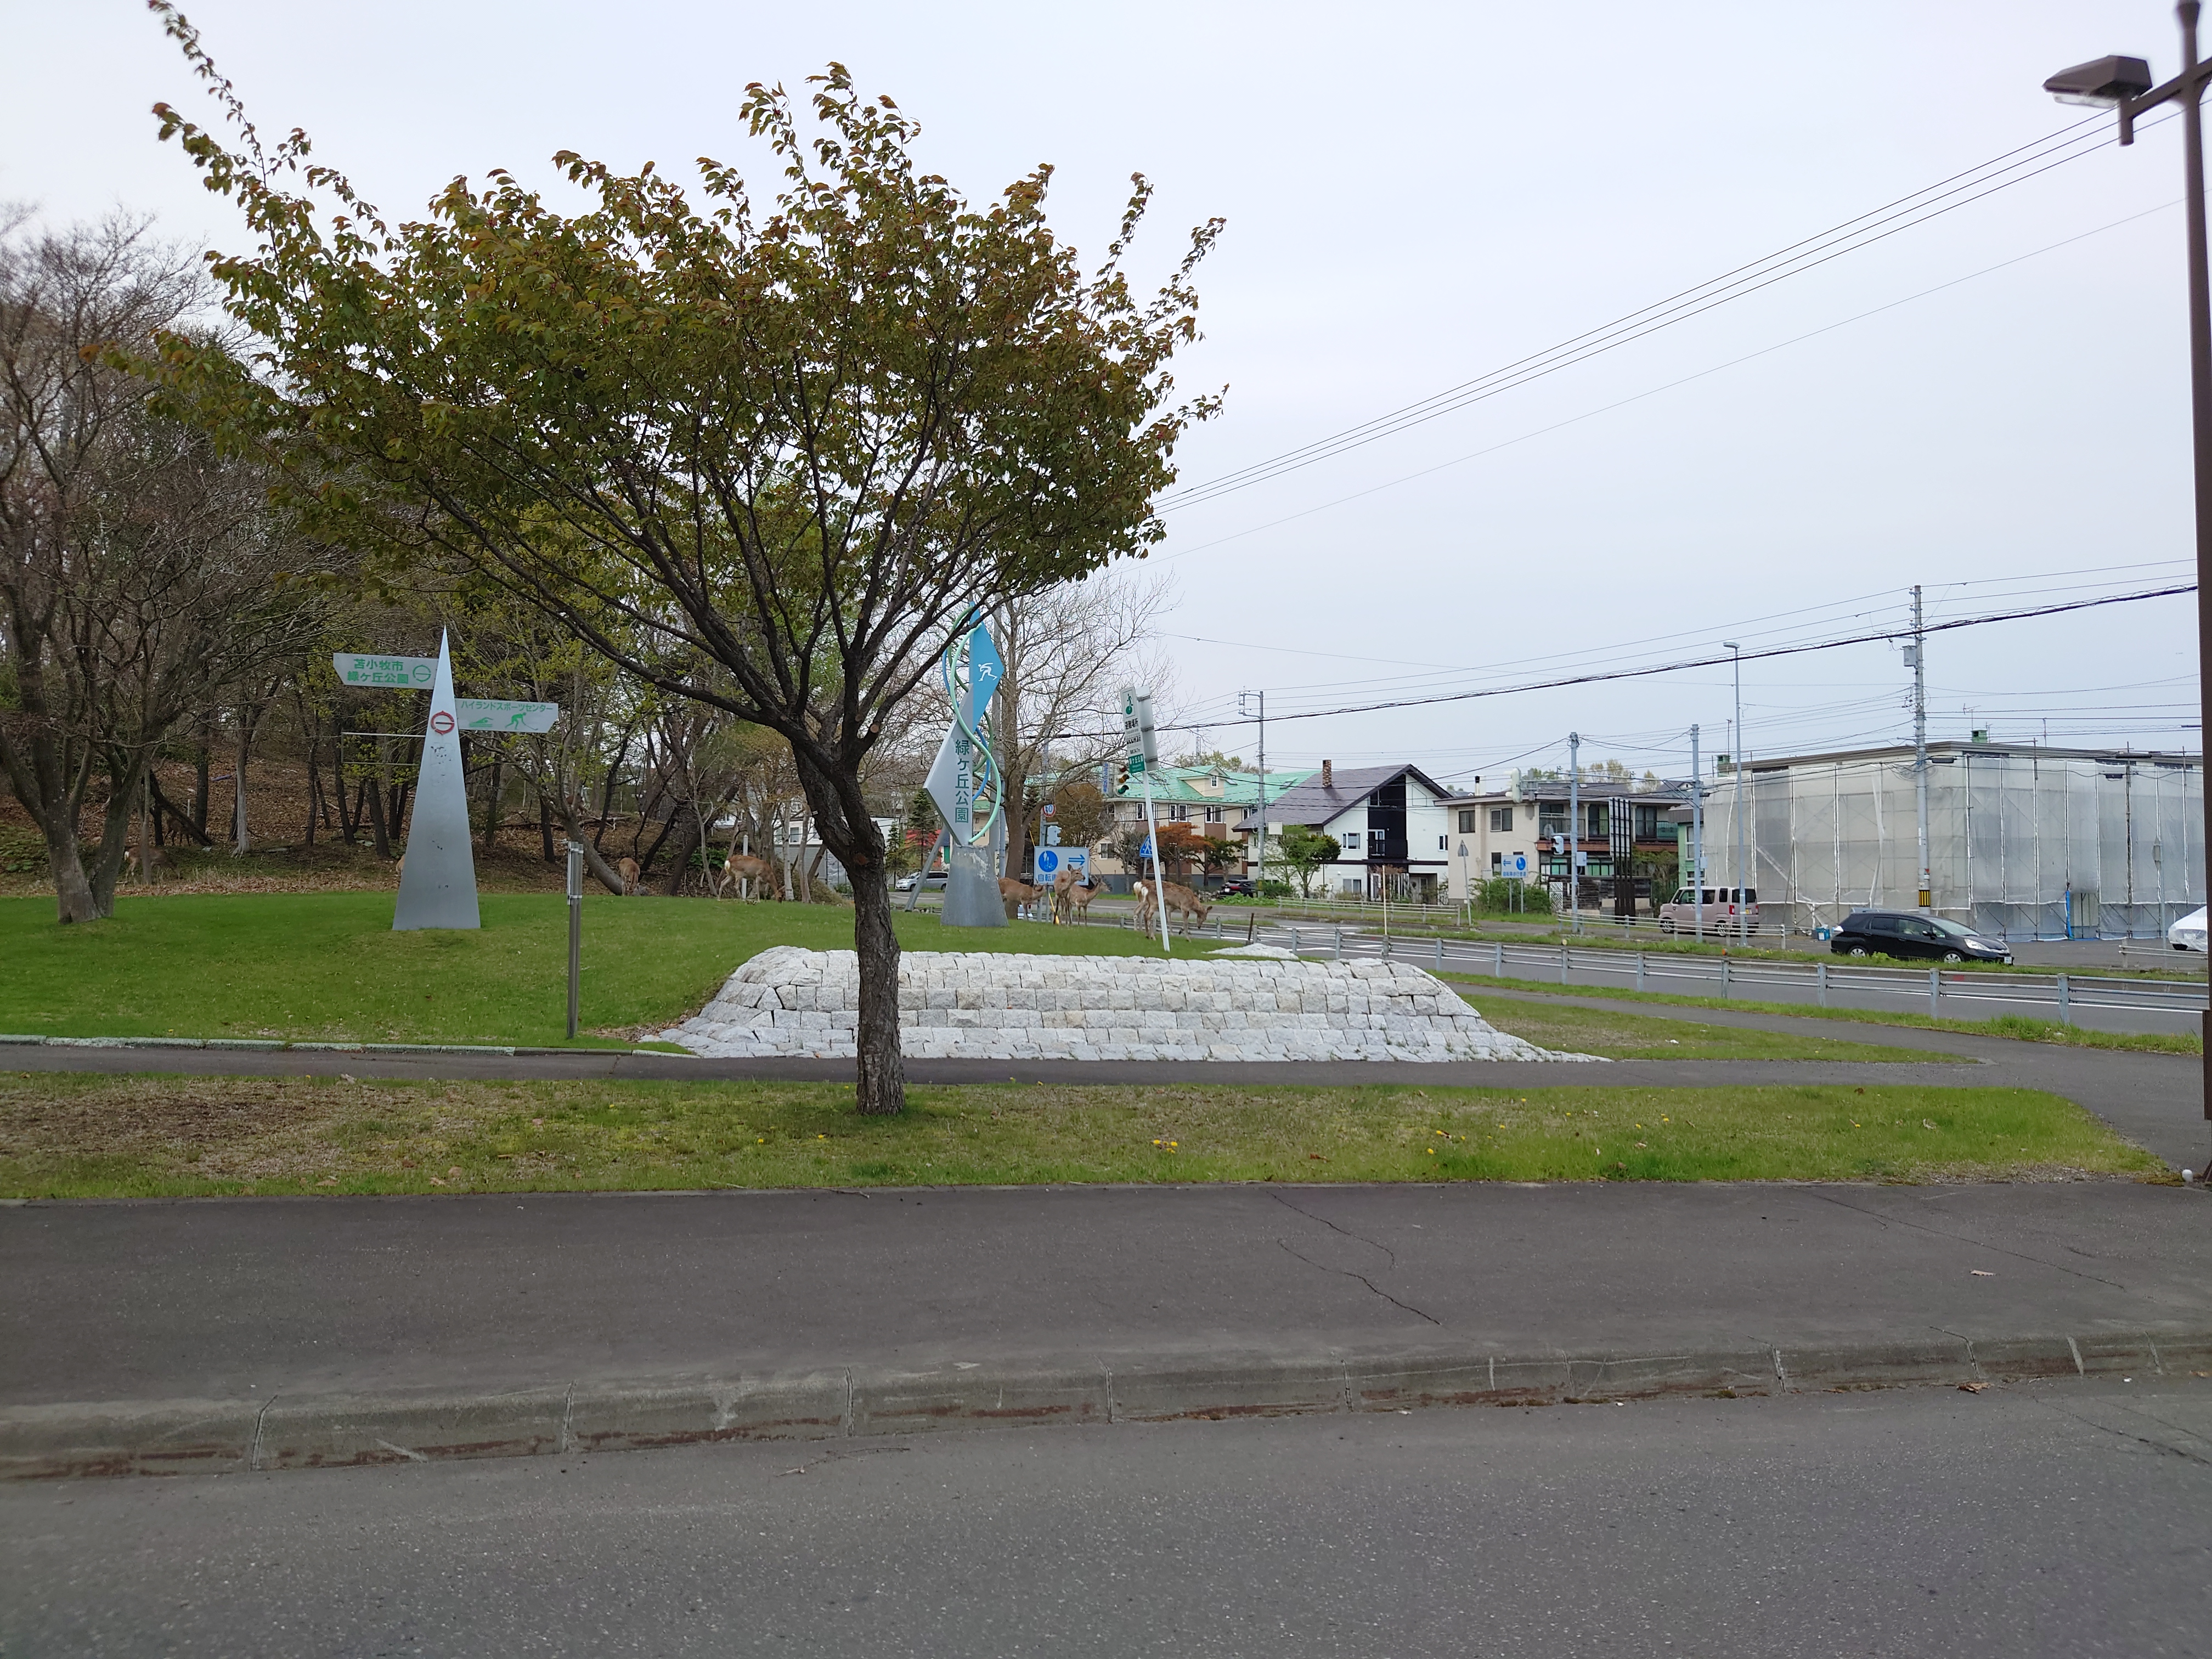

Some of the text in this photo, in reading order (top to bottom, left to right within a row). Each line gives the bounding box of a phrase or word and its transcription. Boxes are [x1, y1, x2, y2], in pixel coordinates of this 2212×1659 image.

[354, 658, 403, 671] 苫小牧市
[461, 701, 553, 712] ハイランドスポーツセンター
[955, 740, 969, 823] 緑ケ丘公園
